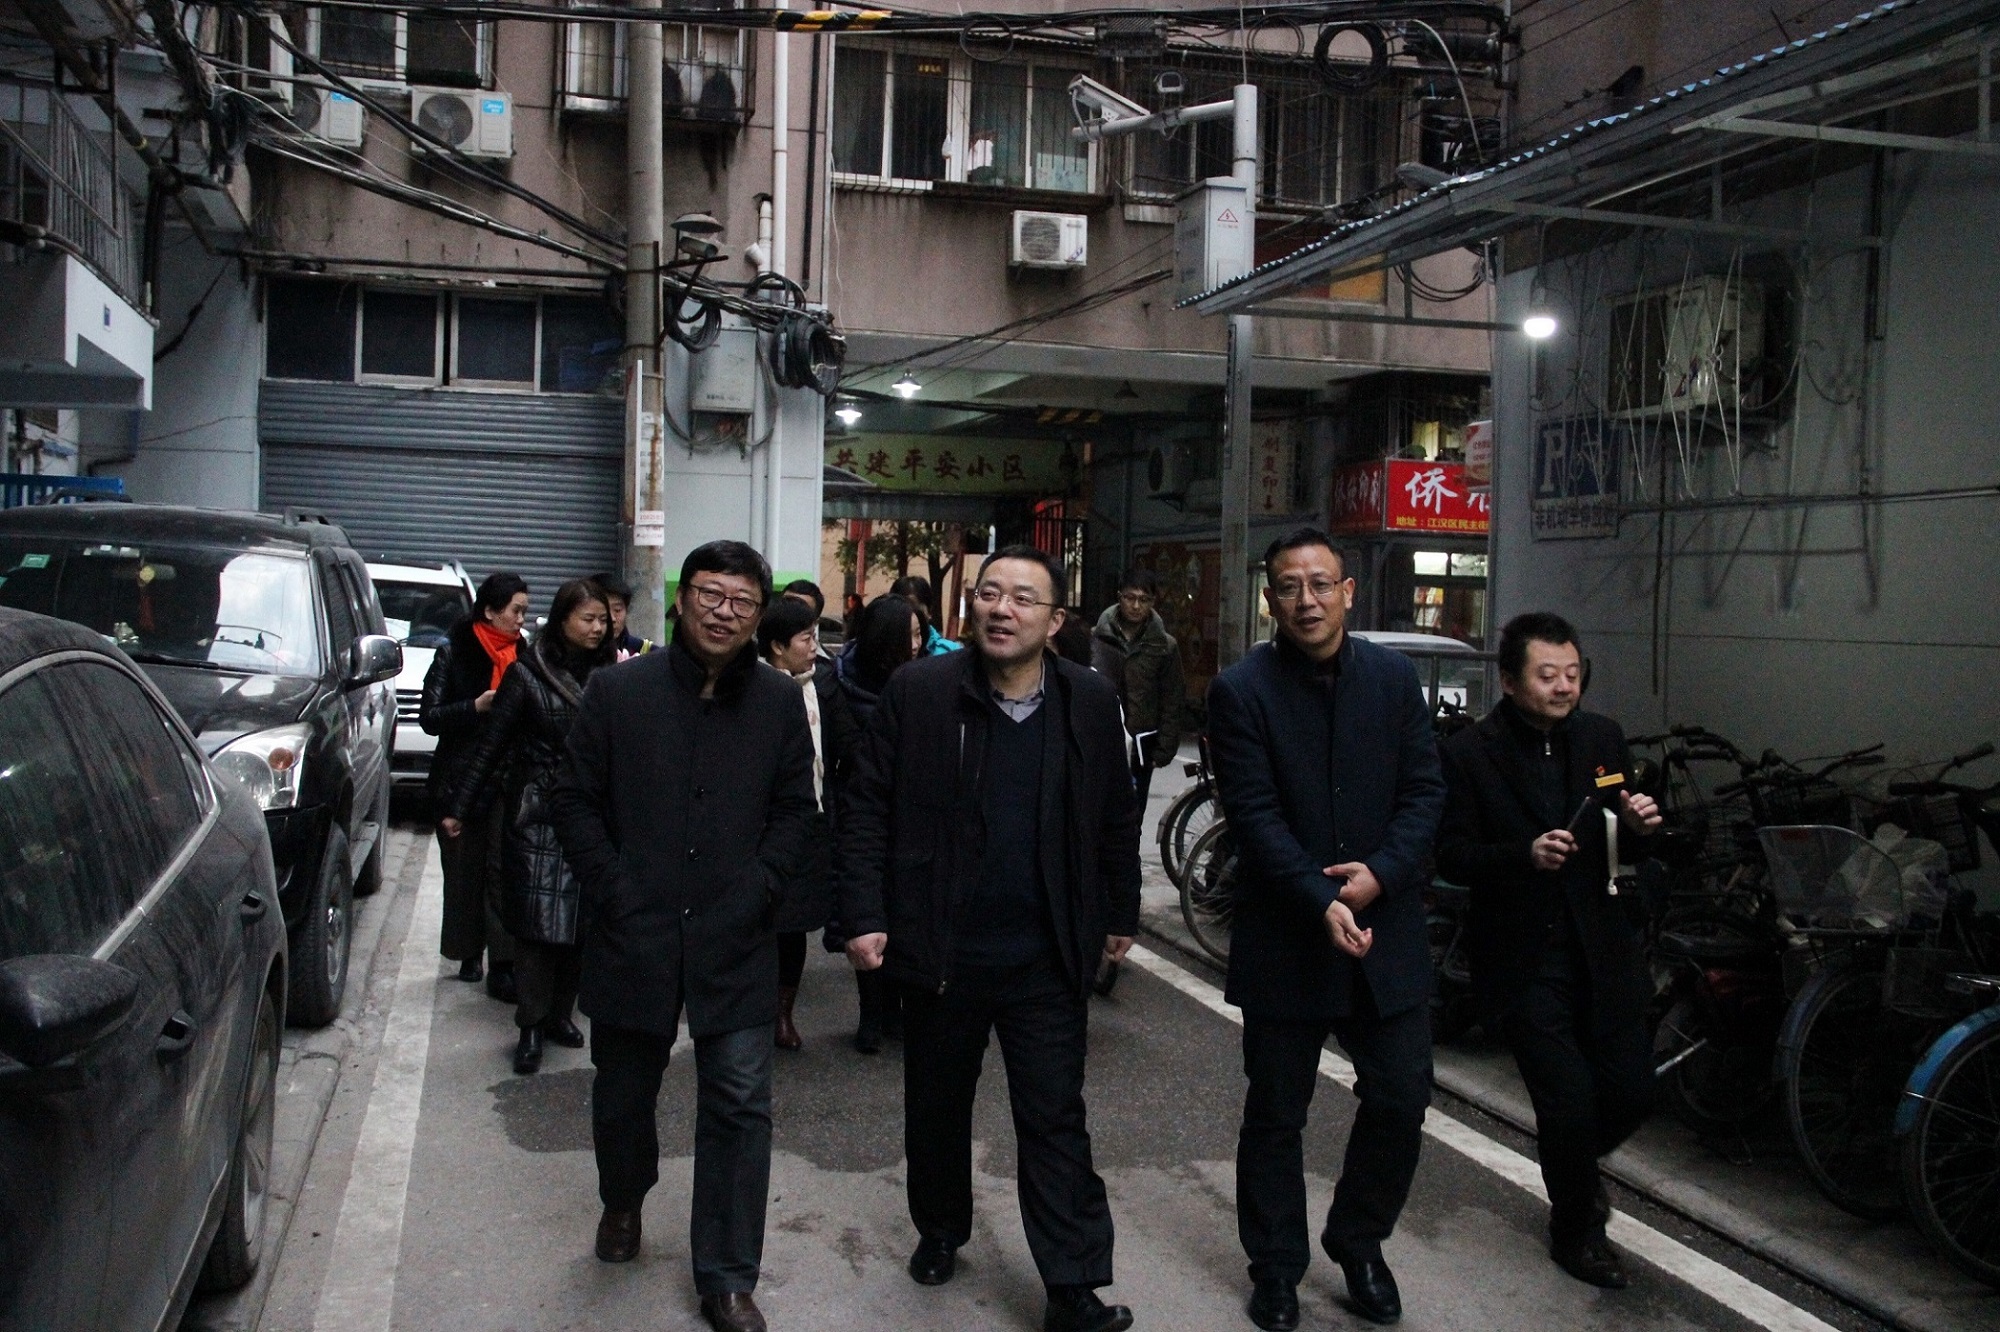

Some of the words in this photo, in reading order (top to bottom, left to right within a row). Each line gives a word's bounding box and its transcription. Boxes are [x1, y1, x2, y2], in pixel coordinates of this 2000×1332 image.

[830, 448, 1025, 481] 共建平安小区
[1540, 429, 1567, 492] P
